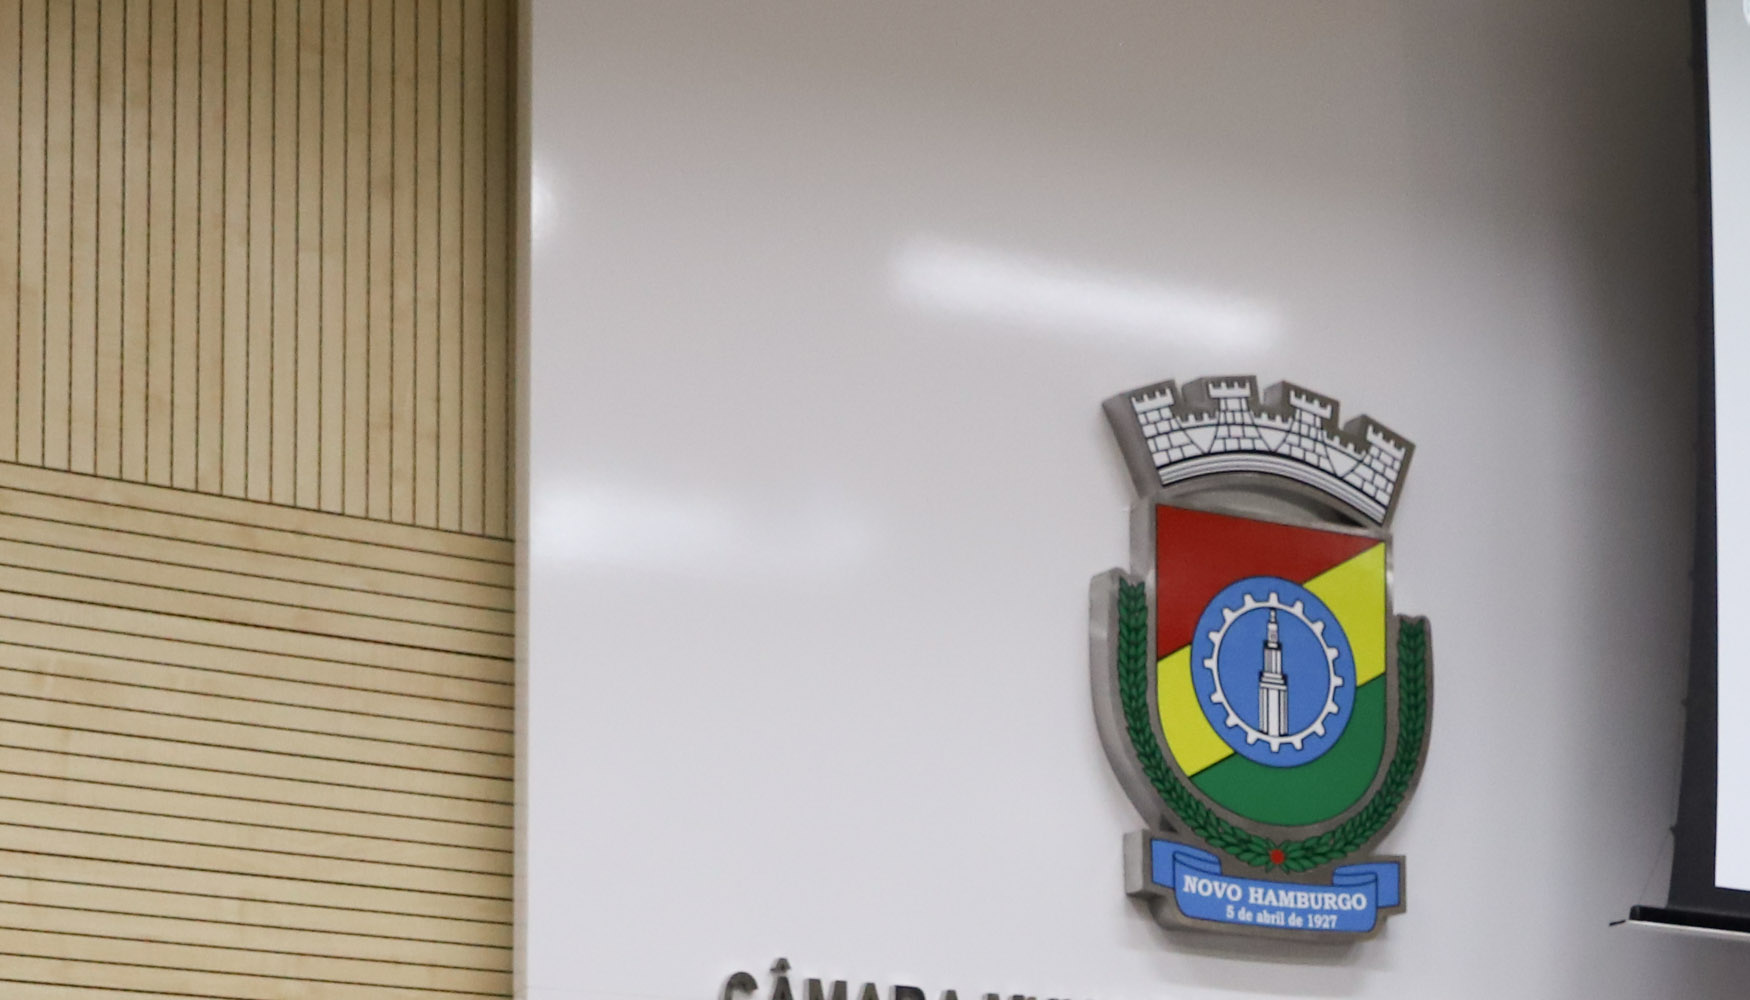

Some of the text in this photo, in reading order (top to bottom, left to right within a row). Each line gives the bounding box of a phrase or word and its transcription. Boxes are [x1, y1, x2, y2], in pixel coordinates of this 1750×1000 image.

[1183, 875, 1367, 911] NOVO HAMBURGO
[1226, 905, 1338, 929] 5 de abril de 1927
